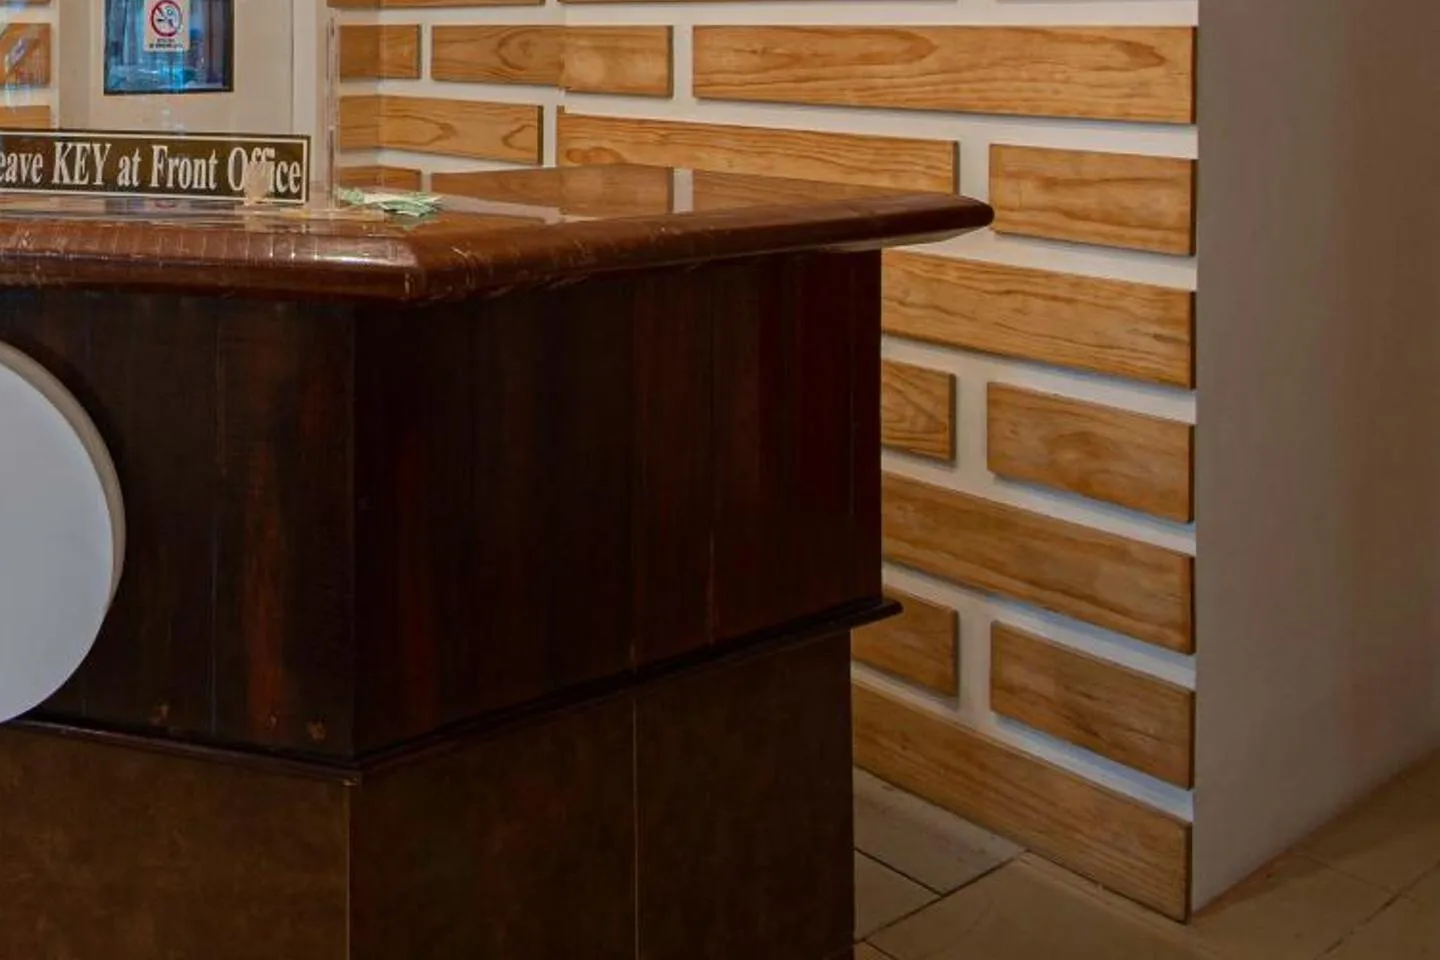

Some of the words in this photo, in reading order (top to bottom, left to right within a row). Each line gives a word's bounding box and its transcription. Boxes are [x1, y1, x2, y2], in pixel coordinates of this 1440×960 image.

[51, 141, 112, 185] KEY
[116, 147, 142, 187] at
[149, 145, 218, 190] Front
